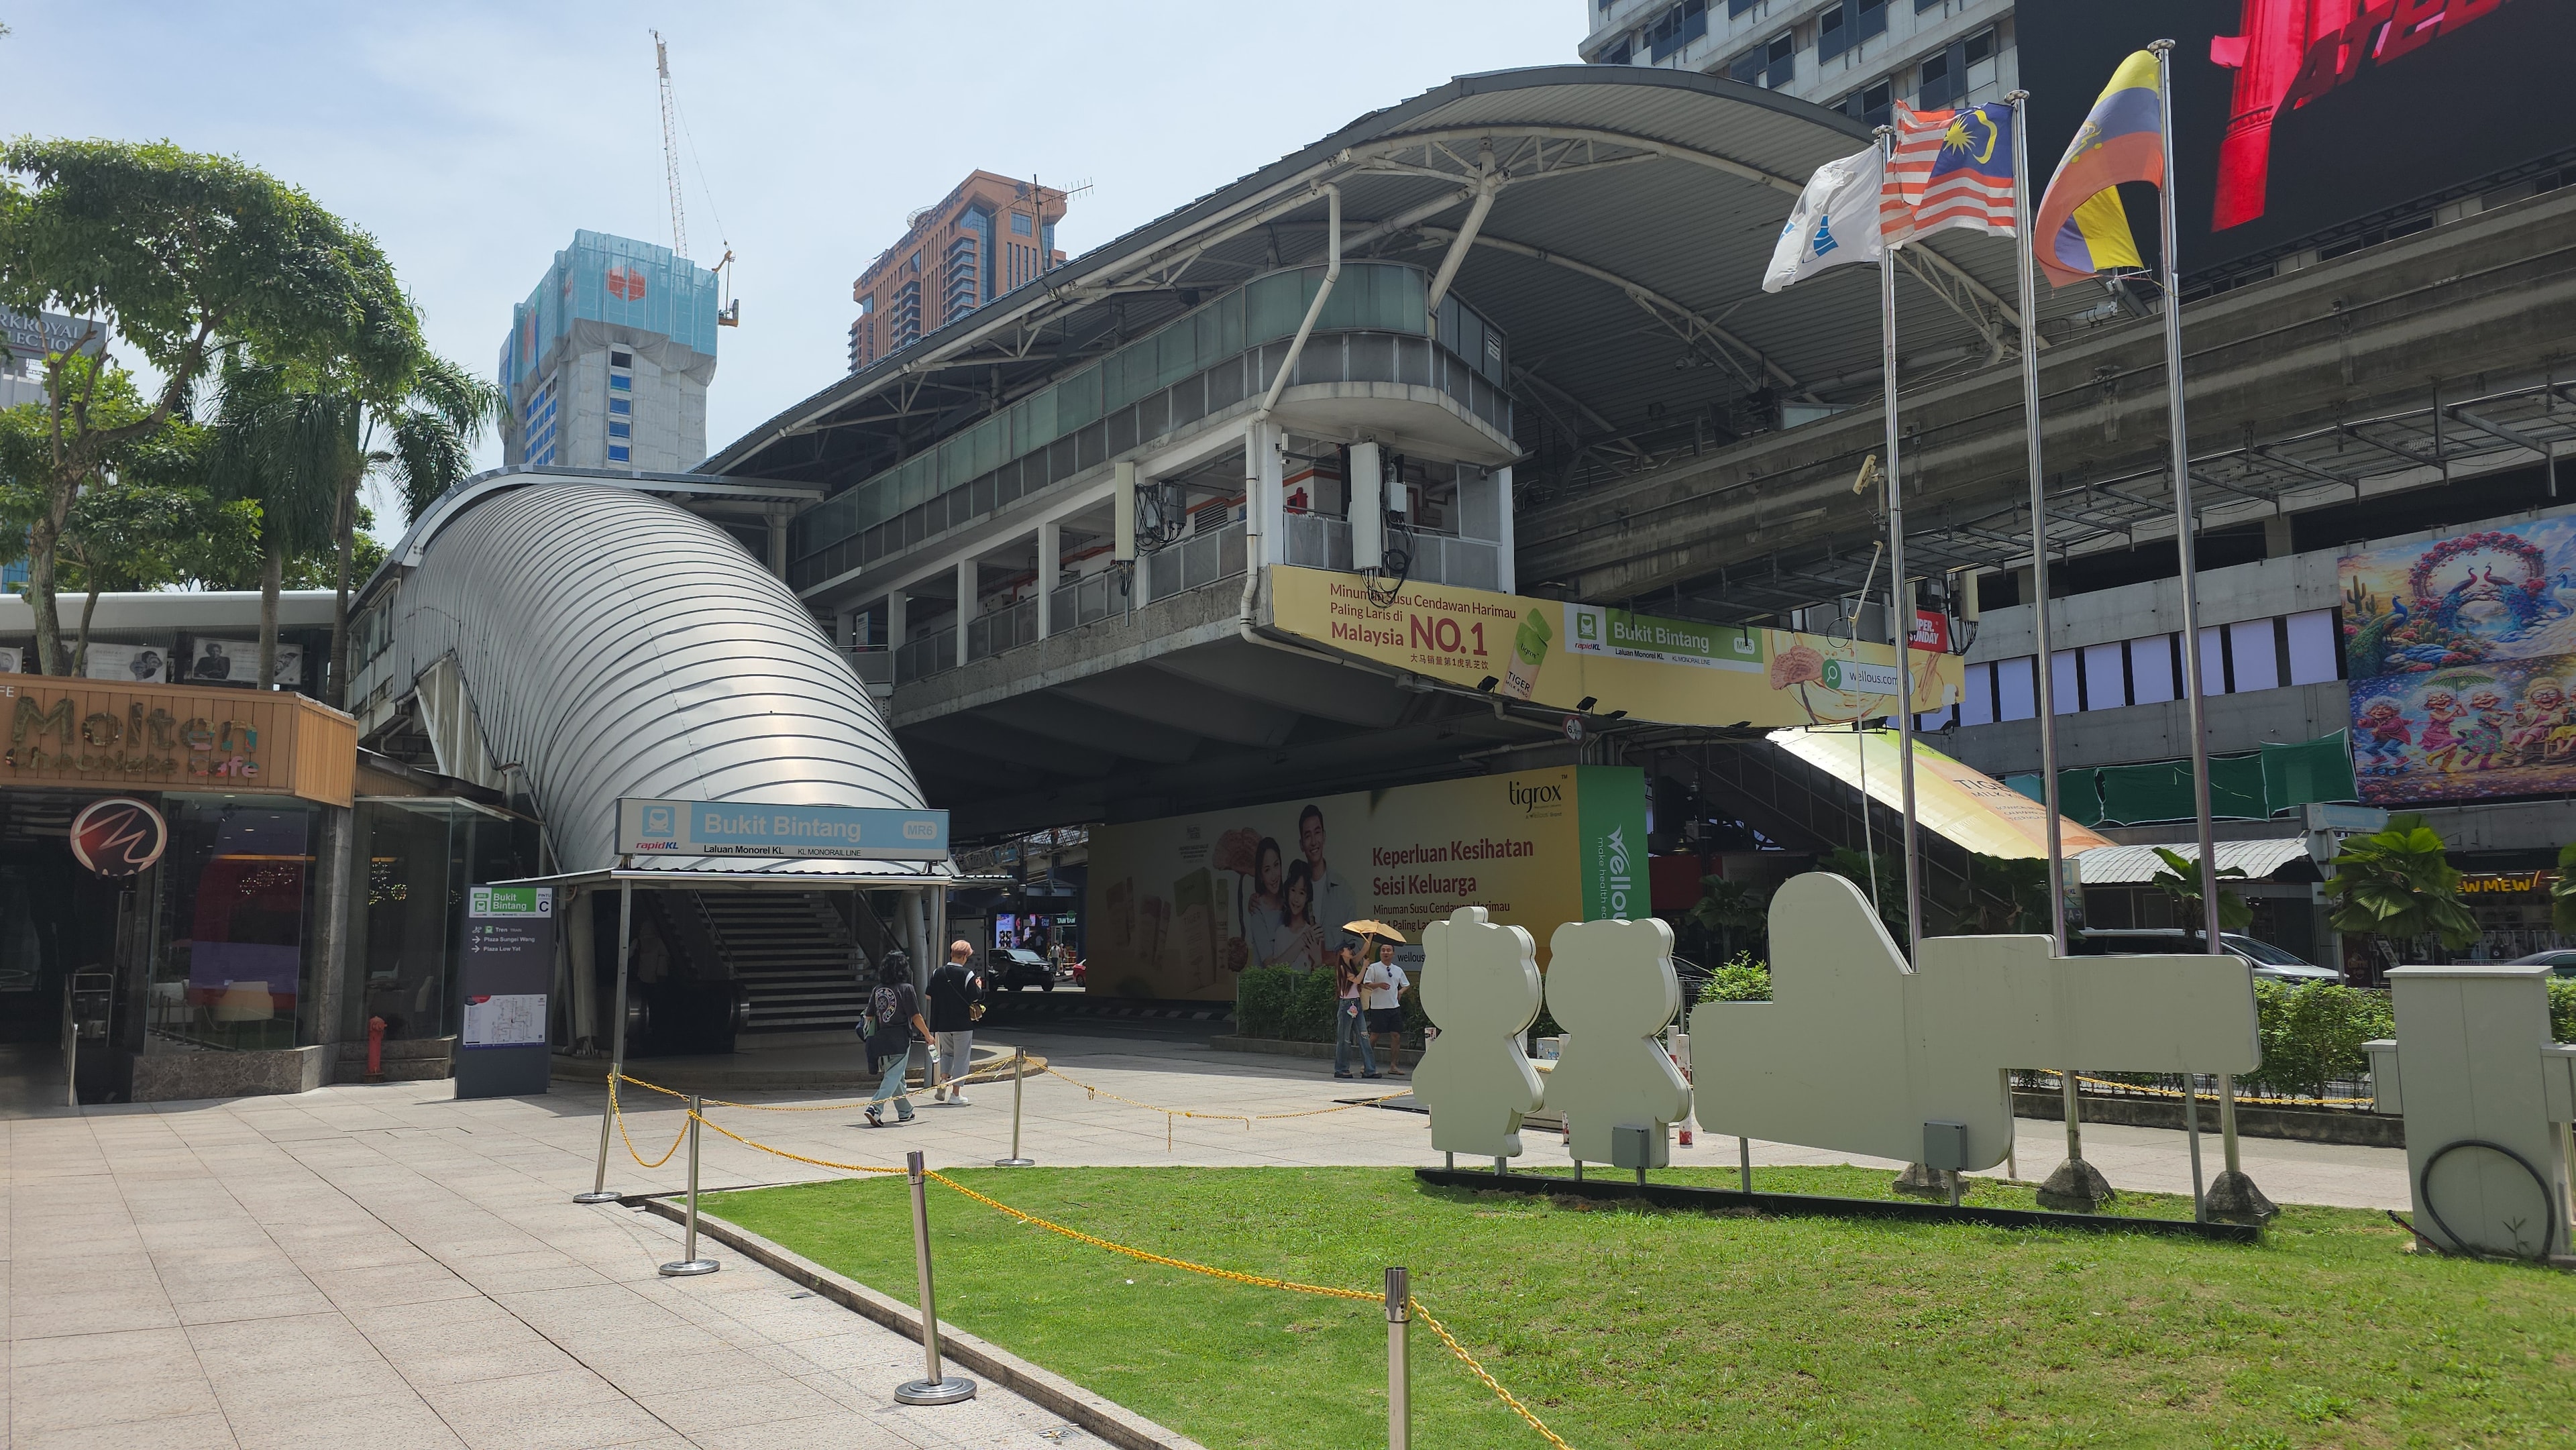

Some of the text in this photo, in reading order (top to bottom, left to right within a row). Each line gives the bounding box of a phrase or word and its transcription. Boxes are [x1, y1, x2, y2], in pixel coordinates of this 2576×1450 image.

[1330, 602, 1403, 622] Paling Laris di
[1414, 594, 1470, 613] Cendawan
[1472, 602, 1516, 618] Harimau
[1332, 621, 1404, 647] Malaysia
[1614, 621, 1652, 644] Bukit
[1656, 627, 1709, 654] Bintang
[1574, 642, 1601, 651] rapidKL
[1615, 648, 1664, 660] Laluan Monorel KL
[1508, 671, 1530, 692] TIGER
[12, 695, 258, 752] Molten
[188, 754, 260, 779] Cafe
[1509, 781, 1562, 814] tigrox
[704, 813, 933, 844] Bukit Bintang MR6
[636, 841, 679, 851] rapidKL
[704, 844, 784, 855] Laluan Monorel KL
[808, 848, 845, 856] MONORAIL
[1373, 838, 1534, 869] Keperluan Kesihatan
[1598, 838, 1606, 867] make
[1373, 873, 1477, 897] Seisi Keluarga
[1599, 869, 1608, 903] health
[493, 901, 527, 911] Bintang
[494, 893, 517, 901] Bukit
[539, 901, 549, 912] C
[1374, 904, 1408, 915] Minuman
[1410, 903, 1428, 913] Susu
[1430, 901, 1472, 913] Cendaw
[1393, 920, 1416, 932] Paling
